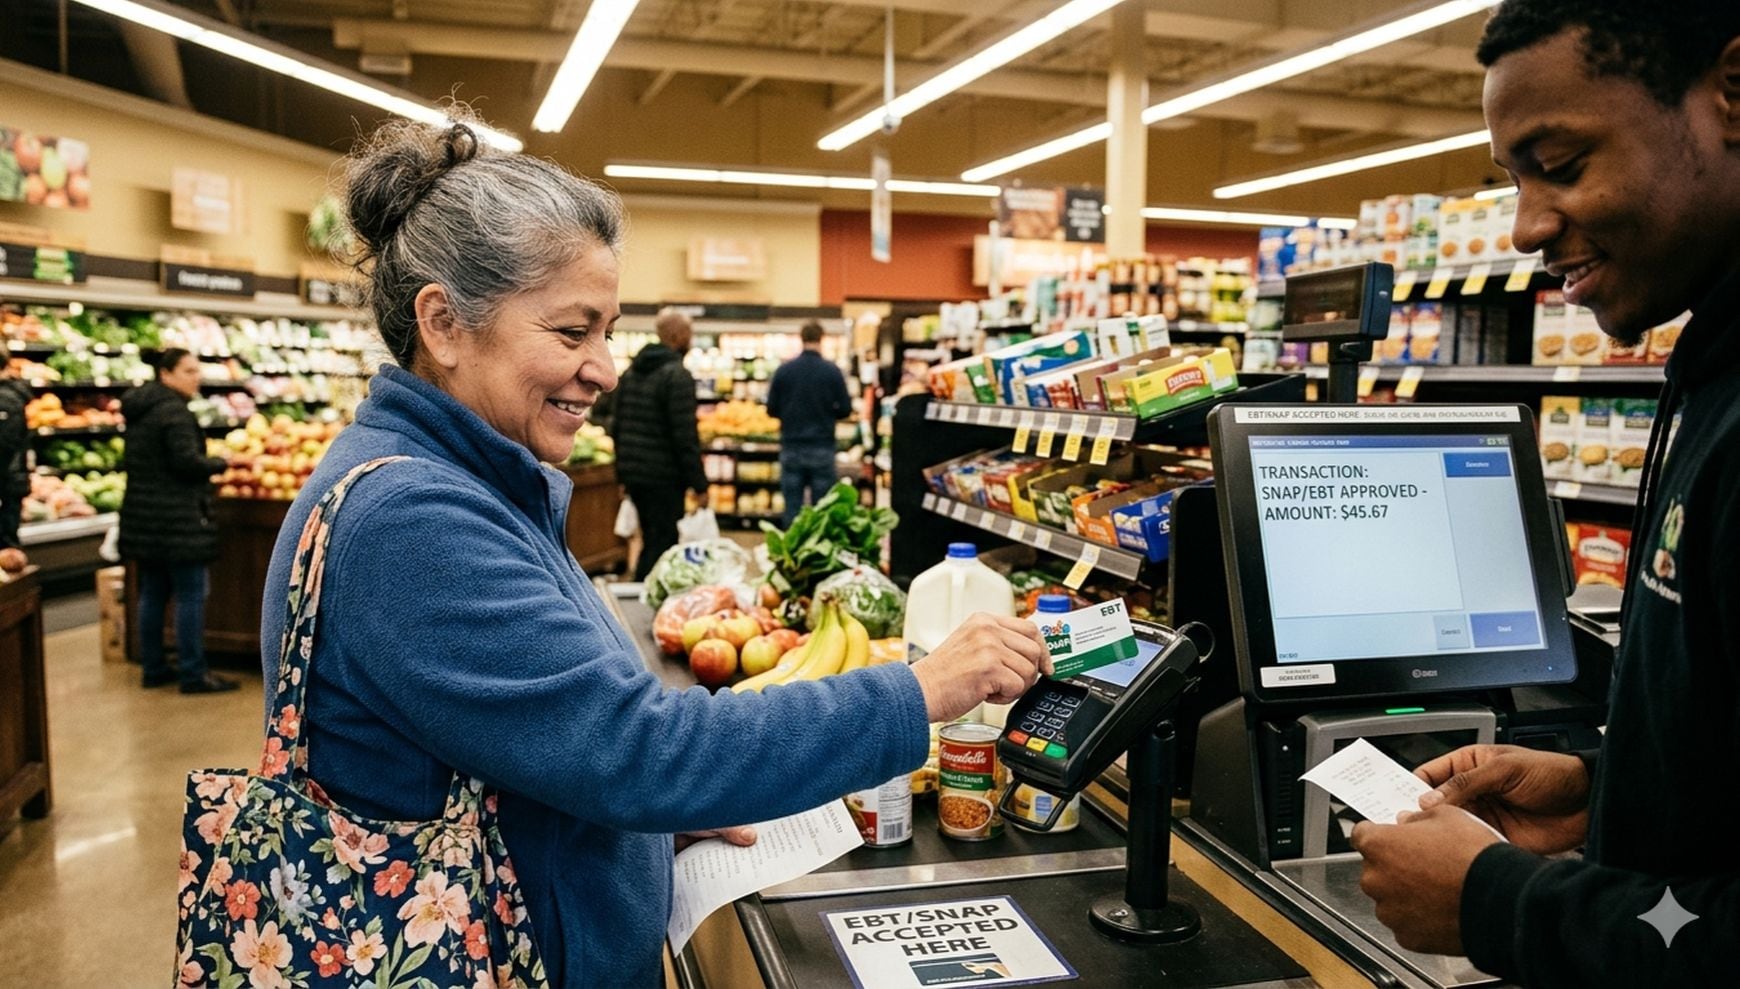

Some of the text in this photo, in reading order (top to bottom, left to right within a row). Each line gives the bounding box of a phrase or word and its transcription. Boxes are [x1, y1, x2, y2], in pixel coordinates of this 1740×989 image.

[1259, 465, 1369, 479] TRANSACTION:
[1261, 485, 1335, 502] SNAP/EBT
[1340, 484, 1418, 498] APPROVED
[1265, 504, 1388, 521] AMOUNT: $45.67
[1100, 603, 1121, 617] EBT
[843, 904, 1000, 929] EBT/SNAP
[851, 918, 1018, 945] ACCEPTED
[900, 937, 991, 956] HERE
